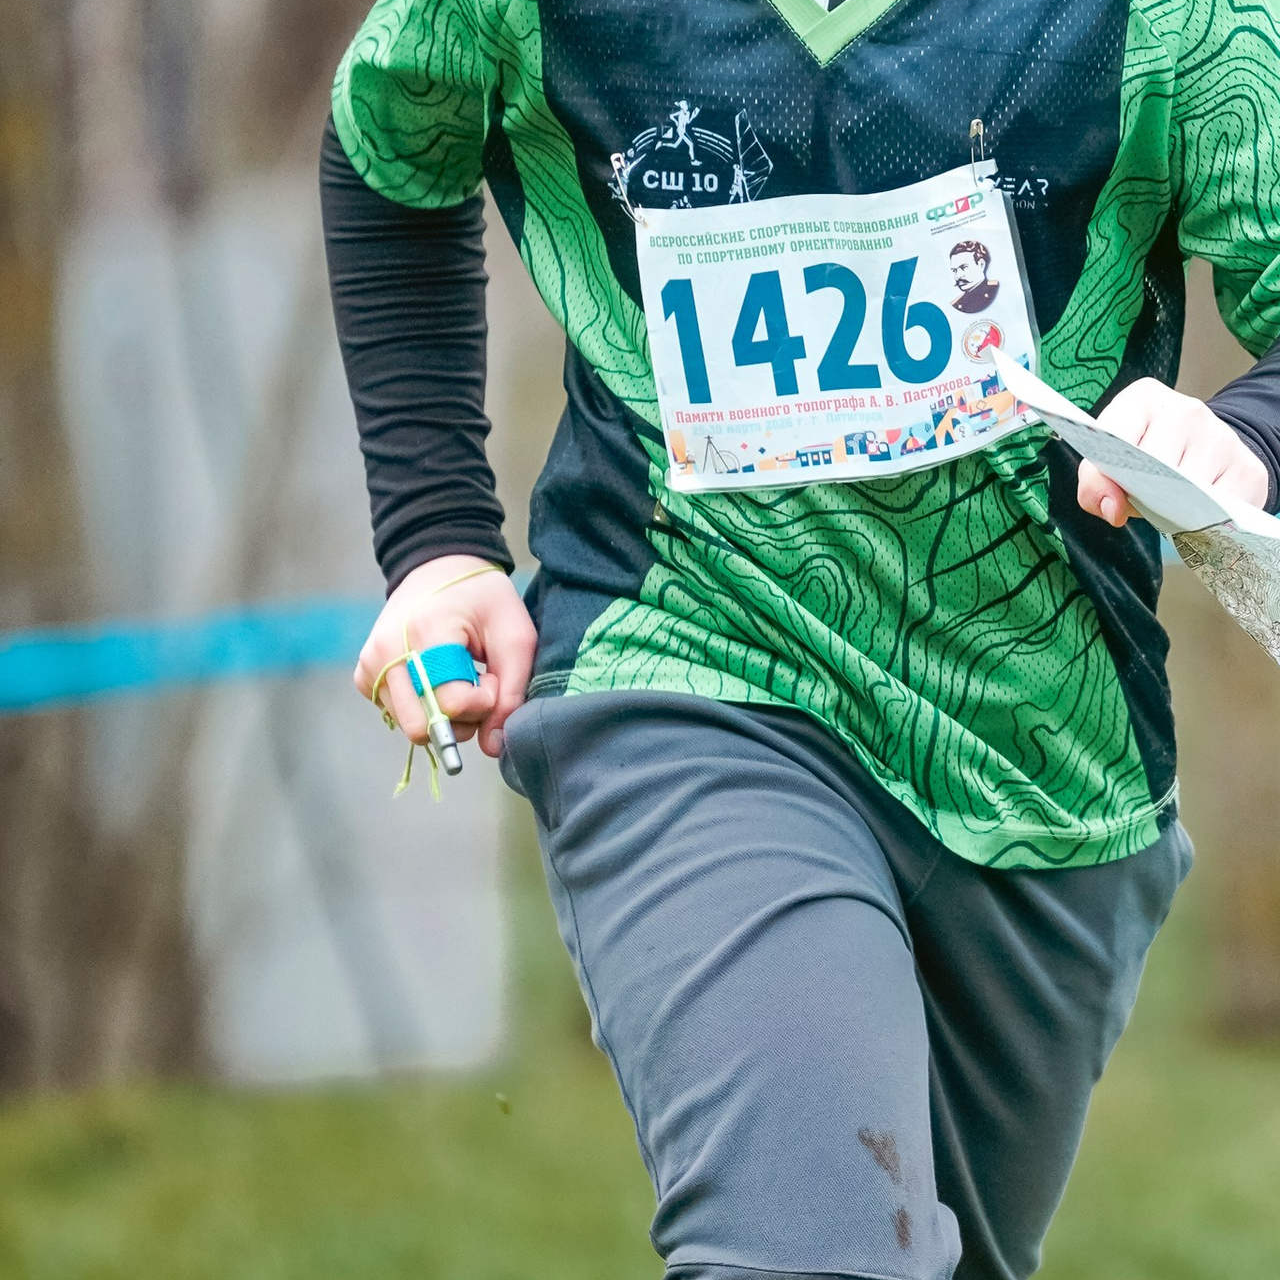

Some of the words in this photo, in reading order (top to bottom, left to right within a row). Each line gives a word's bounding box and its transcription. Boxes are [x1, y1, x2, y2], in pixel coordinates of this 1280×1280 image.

[642, 169, 684, 191] СШ
[692, 172, 719, 192] 10
[649, 231, 745, 248] ВСЕРОССИЙСКИЕ
[749, 221, 830, 240] СПОРТИВНЫЕ
[833, 212, 919, 233] СОРЕВНОВАНИЯ
[677, 252, 693, 265] ПО
[697, 242, 785, 264] СПОРТИВНОМУ
[791, 236, 893, 252] ОРИЕНТИРОВАНИЮ
[660, 256, 953, 405] 1426
[676, 410, 724, 423] Памяти
[729, 404, 790, 421] военного
[795, 395, 865, 412] топографа
[870, 395, 881, 408] А.
[885, 395, 898, 407] В.
[903, 375, 971, 404] Пастухова
